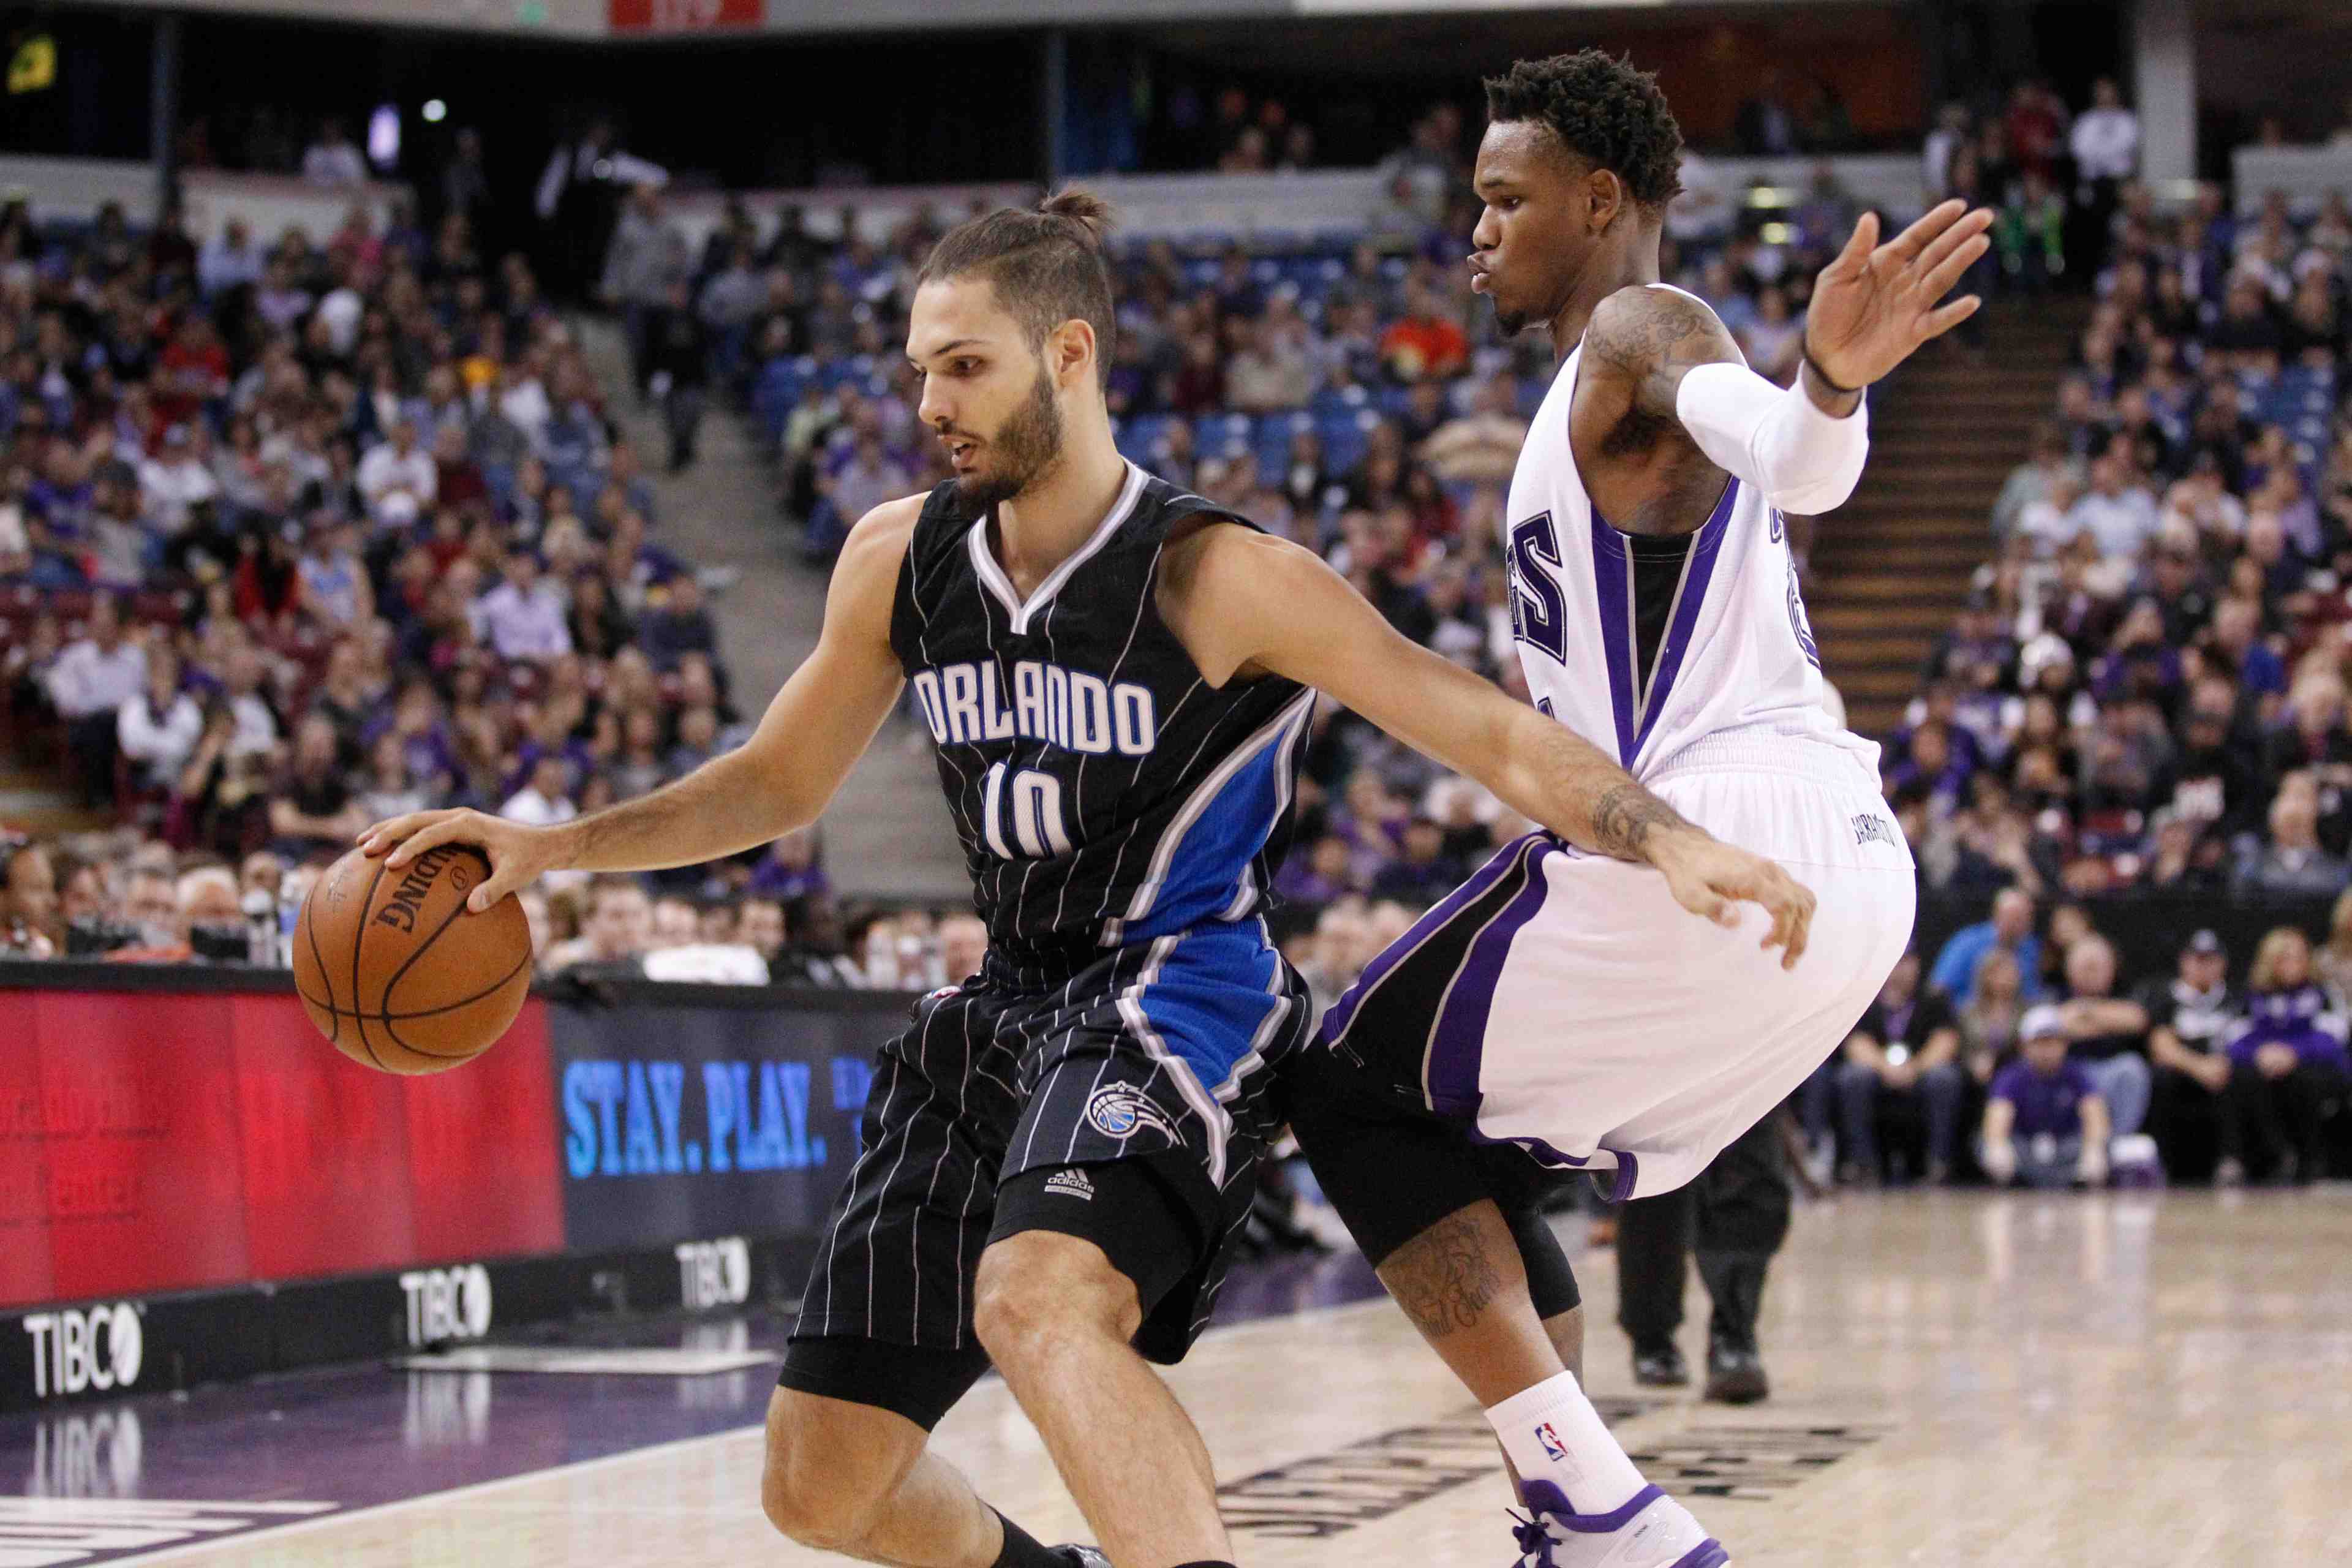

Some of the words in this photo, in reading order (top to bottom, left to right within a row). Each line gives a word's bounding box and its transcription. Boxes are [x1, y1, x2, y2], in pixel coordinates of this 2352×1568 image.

[913, 659, 1155, 755] ORLANDO
[984, 761, 1073, 860] 10
[564, 1060, 703, 1178] STAY.
[701, 1060, 827, 1172] PLAY.
[1047, 1176, 1095, 1193] adidas
[23, 1301, 143, 1398] TIBCO
[399, 1263, 491, 1347] TIBCO
